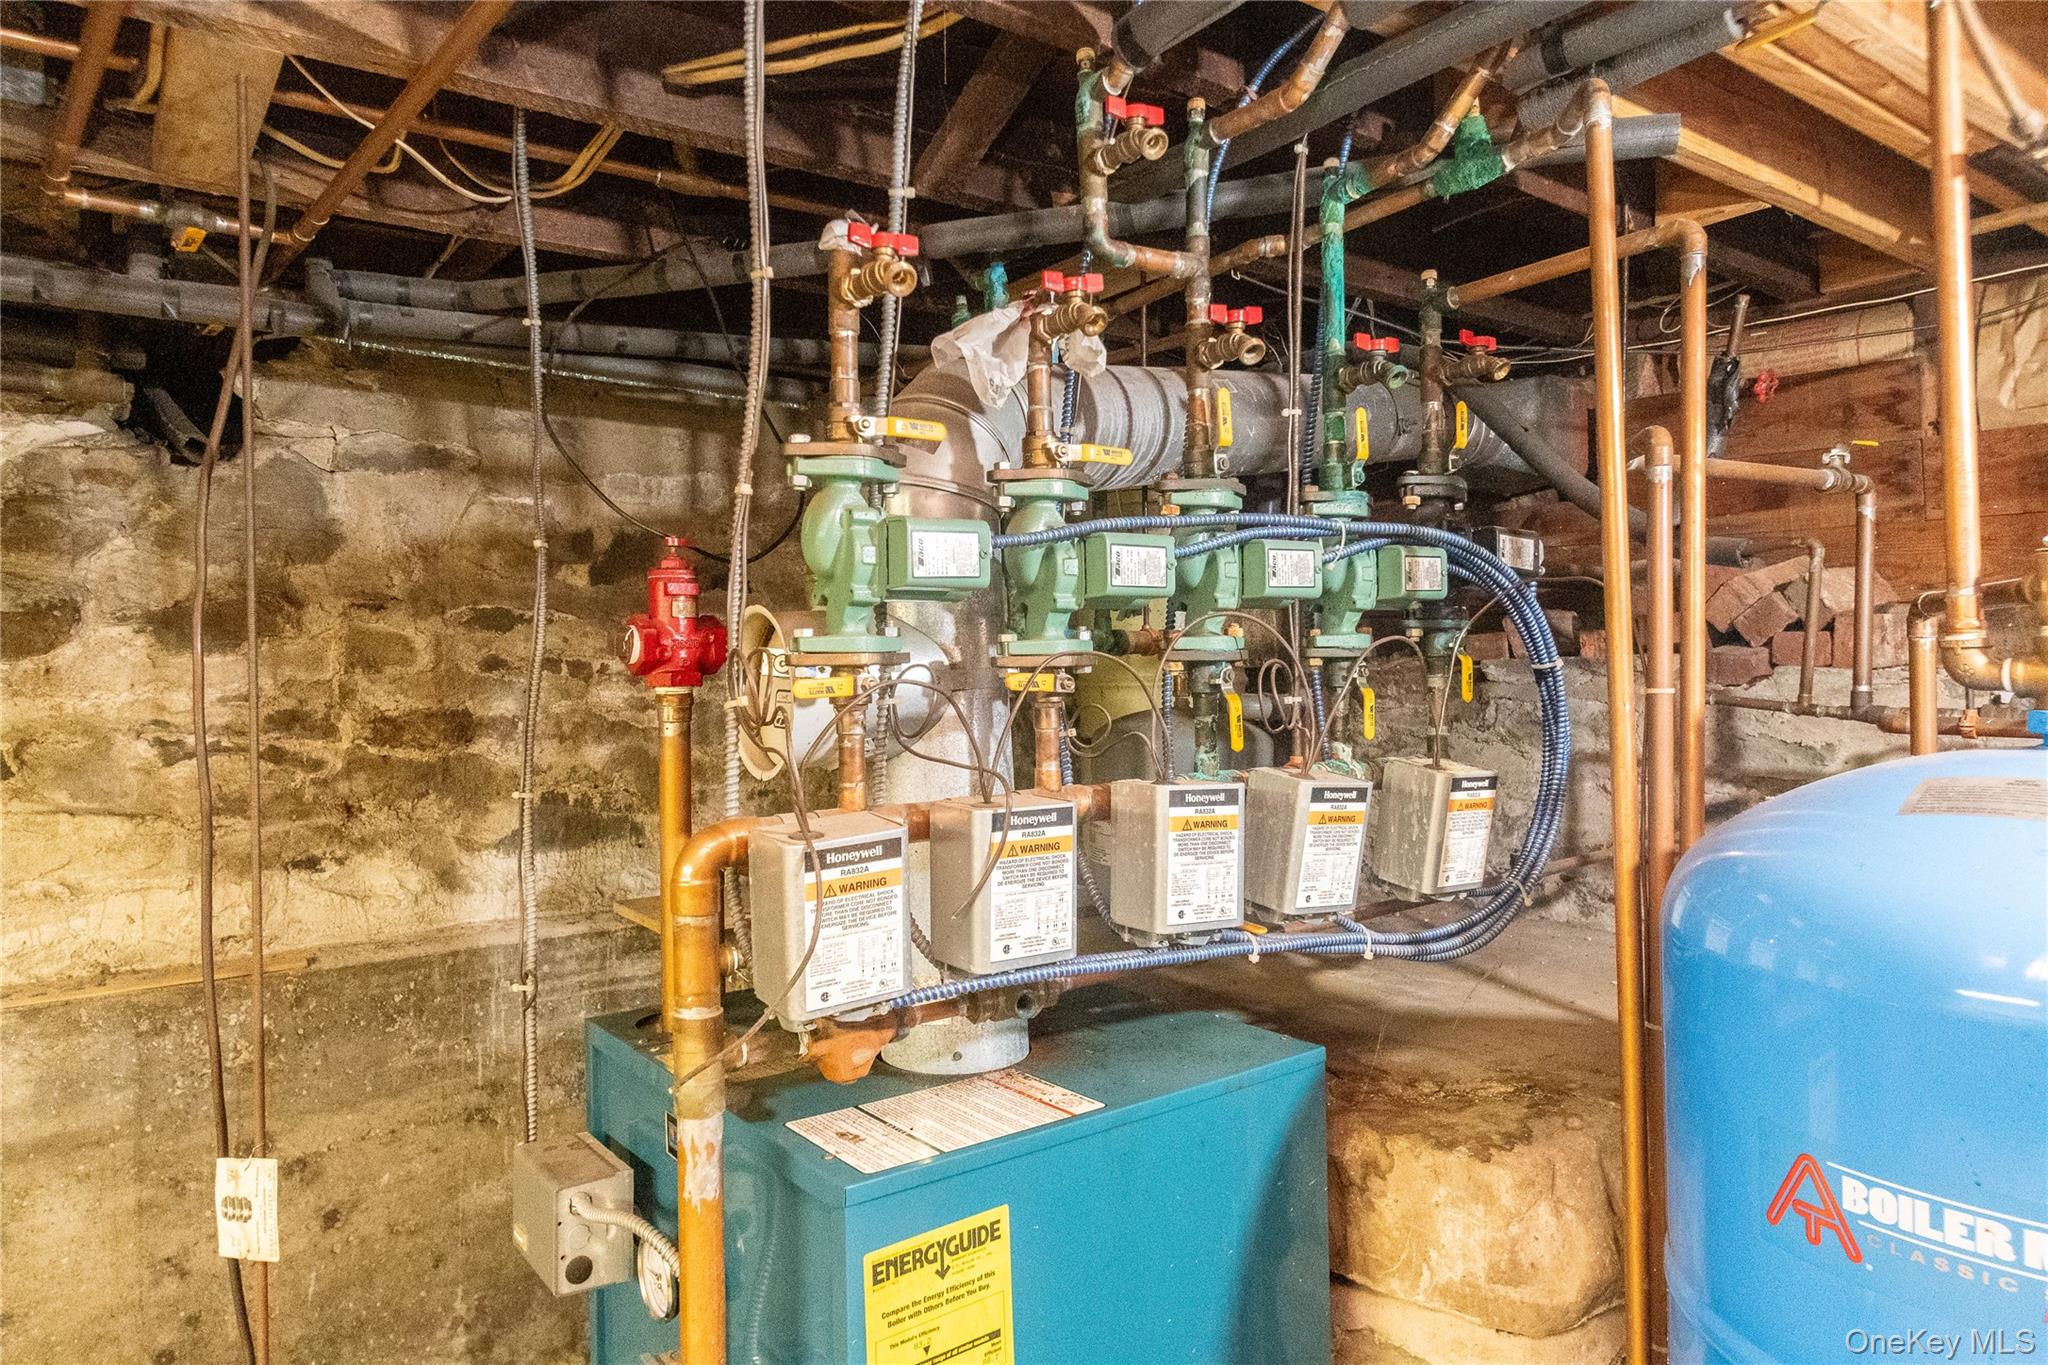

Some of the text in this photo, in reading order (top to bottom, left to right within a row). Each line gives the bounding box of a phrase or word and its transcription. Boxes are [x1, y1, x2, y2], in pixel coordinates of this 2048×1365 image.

[1185, 792, 1225, 804] Honeywell
[1324, 790, 1357, 800] Honeywell
[1010, 812, 1057, 826] Honeywell
[1193, 820, 1228, 828] WARNING
[1021, 830, 1046, 839] RA832A
[826, 845, 883, 864] Honeywell
[1019, 841, 1060, 854] WARNING
[841, 865, 870, 877] RA832A
[838, 877, 887, 894] WARNING
[1842, 1174, 2016, 1262] BOILER
[872, 1218, 1001, 1286] ENERGYGUIDE
[1864, 1233, 2019, 1294] CLASSIC
[882, 1304, 910, 1320] Compare
[911, 1299, 922, 1308] the
[923, 1291, 945, 1303] Energy
[946, 1279, 975, 1294] Efficiency
[984, 1270, 995, 1280] this
[888, 1316, 906, 1328] Boiler
[908, 1310, 922, 1321] with
[924, 1302, 943, 1314] Others
[945, 1293, 965, 1305] Before
[966, 1288, 977, 1296] You
